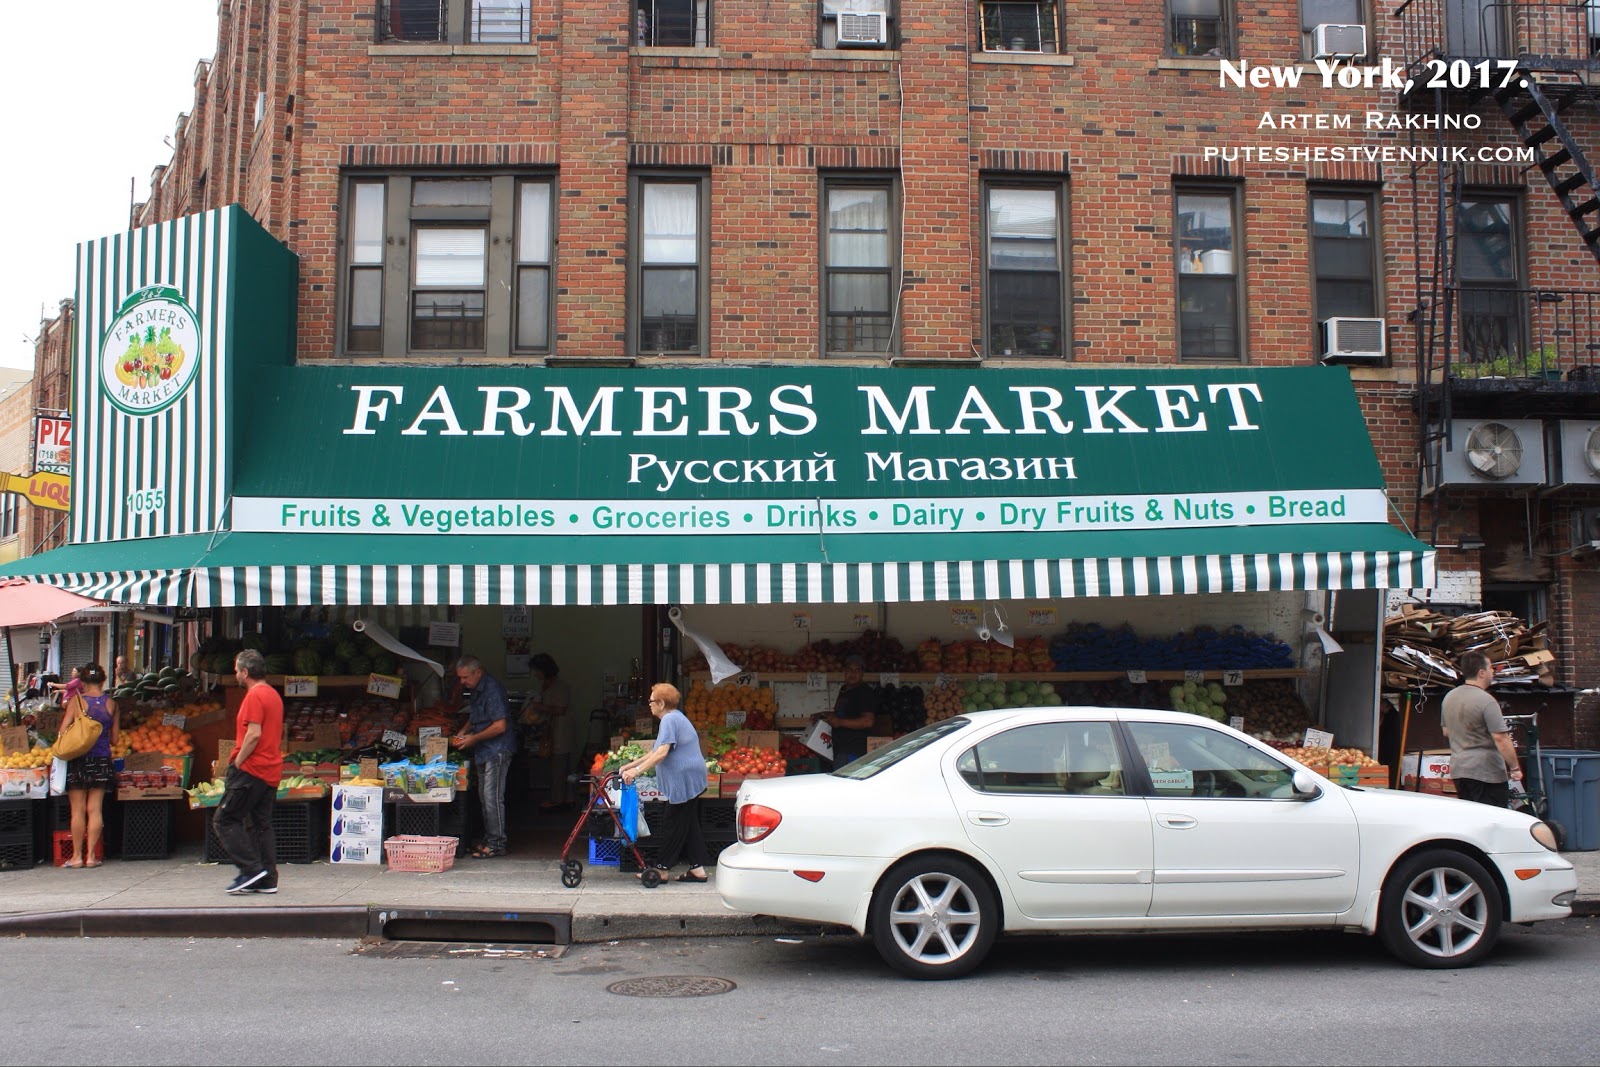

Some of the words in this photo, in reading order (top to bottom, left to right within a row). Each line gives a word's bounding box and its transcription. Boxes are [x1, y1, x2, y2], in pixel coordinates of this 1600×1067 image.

[115, 308, 187, 342] FARMERS
[118, 373, 181, 405] MARKET
[342, 384, 818, 437] FARMERS
[857, 383, 1263, 435] MARKET
[627, 451, 836, 492] Русский
[864, 451, 1078, 482] Магазин
[127, 490, 164, 513] 1055
[281, 503, 361, 528] Fruits
[371, 503, 392, 528] &
[401, 503, 556, 533] Vegetables
[592, 505, 731, 530] Groceries
[767, 504, 858, 527] Drinks
[892, 502, 965, 531] Dairy
[999, 502, 1047, 531] Dry
[1056, 500, 1135, 524] Fruits
[1145, 498, 1164, 522] &
[1173, 498, 1235, 521] Nuts
[1268, 494, 1346, 518] Bread
